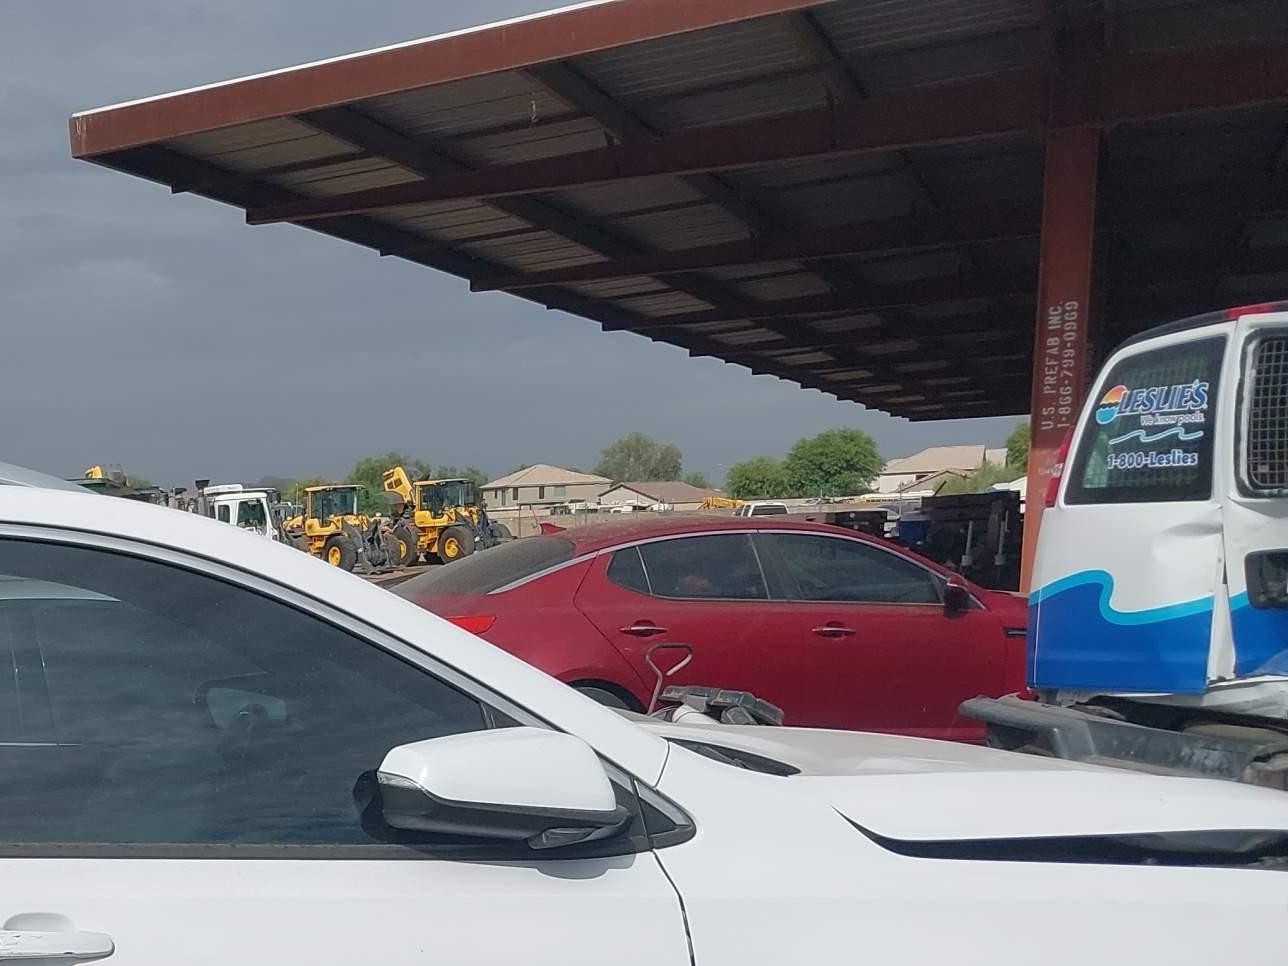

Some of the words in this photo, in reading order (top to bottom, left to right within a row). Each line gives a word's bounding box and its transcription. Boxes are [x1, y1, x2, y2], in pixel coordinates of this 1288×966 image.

[1048, 301, 1063, 330] INC.
[1043, 336, 1060, 394] PREFAB
[1057, 300, 1079, 428] 1-866-799-0969
[1117, 379, 1209, 416] LESLIE'S
[1040, 402, 1056, 430] U.S.
[1106, 449, 1199, 470] 1-800-Leslies
